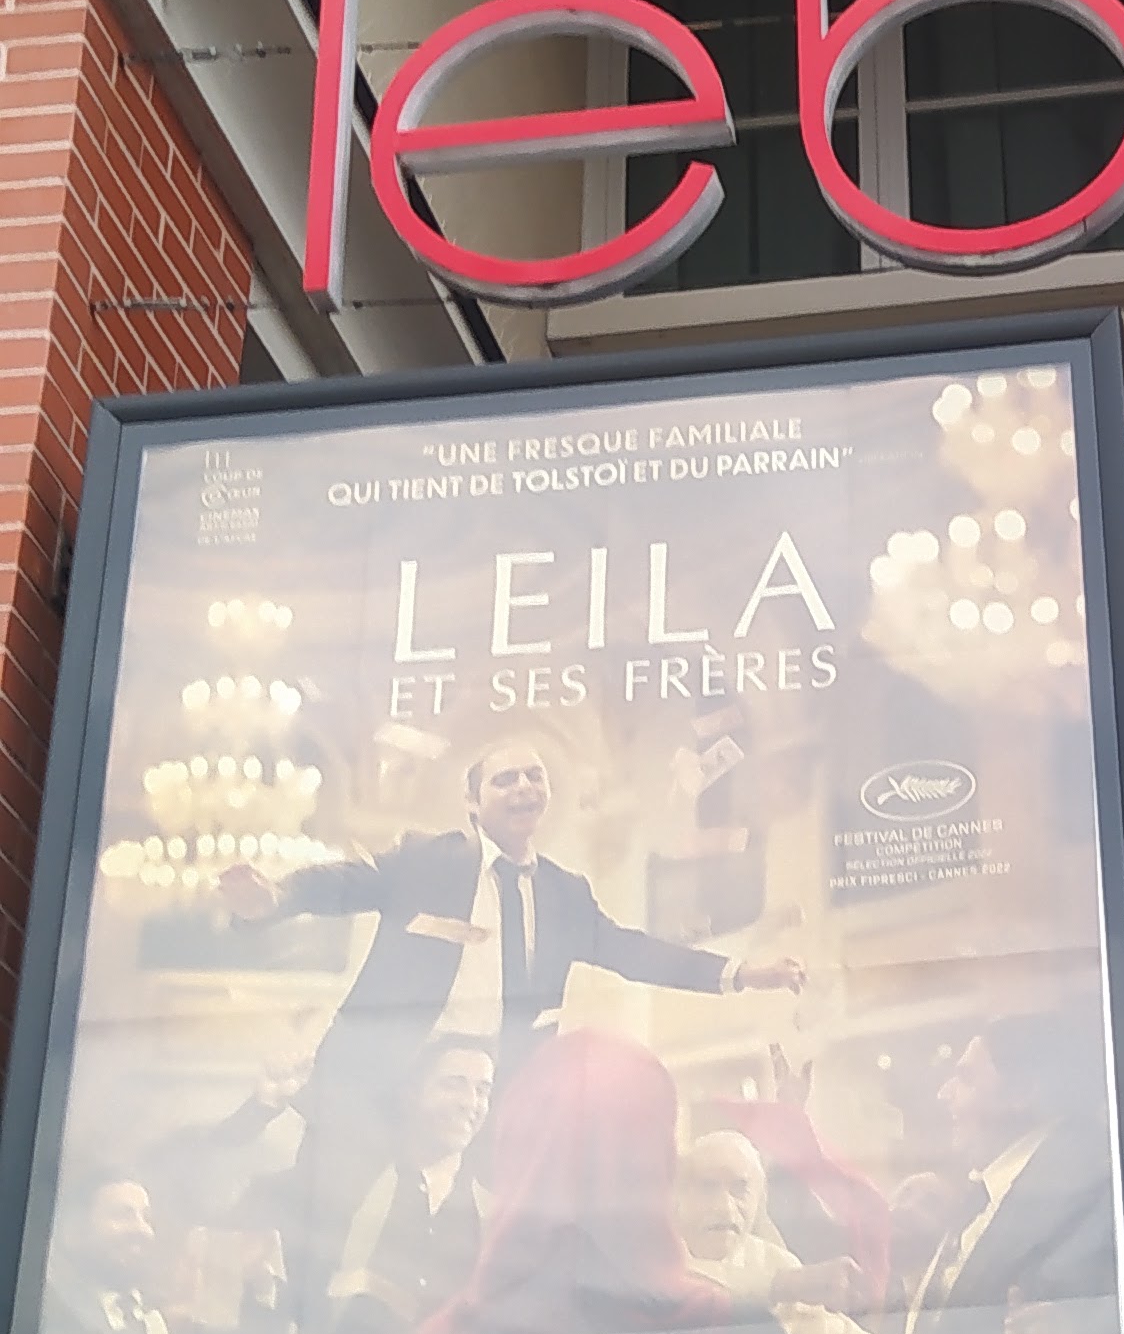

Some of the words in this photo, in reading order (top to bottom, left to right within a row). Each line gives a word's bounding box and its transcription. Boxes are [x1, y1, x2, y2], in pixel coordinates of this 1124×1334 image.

[507, 428, 638, 462] FRESQUE
[649, 417, 803, 449] FAMILIALE
[327, 480, 380, 507] QUI
[388, 474, 464, 502] TIENT
[469, 473, 504, 497] DE
[512, 456, 630, 494] TOLSTOÏ
[633, 458, 663, 484] ET
[669, 456, 709, 482] DU
[394, 531, 836, 665] LEILA
[389, 672, 456, 719] ET
[488, 662, 589, 714] SES
[624, 642, 839, 703] FRÈRES
[833, 828, 909, 847] FESTIVAL
[911, 826, 935, 842] DE
[936, 818, 1004, 839] CANNES
[829, 875, 857, 889] PRIX
